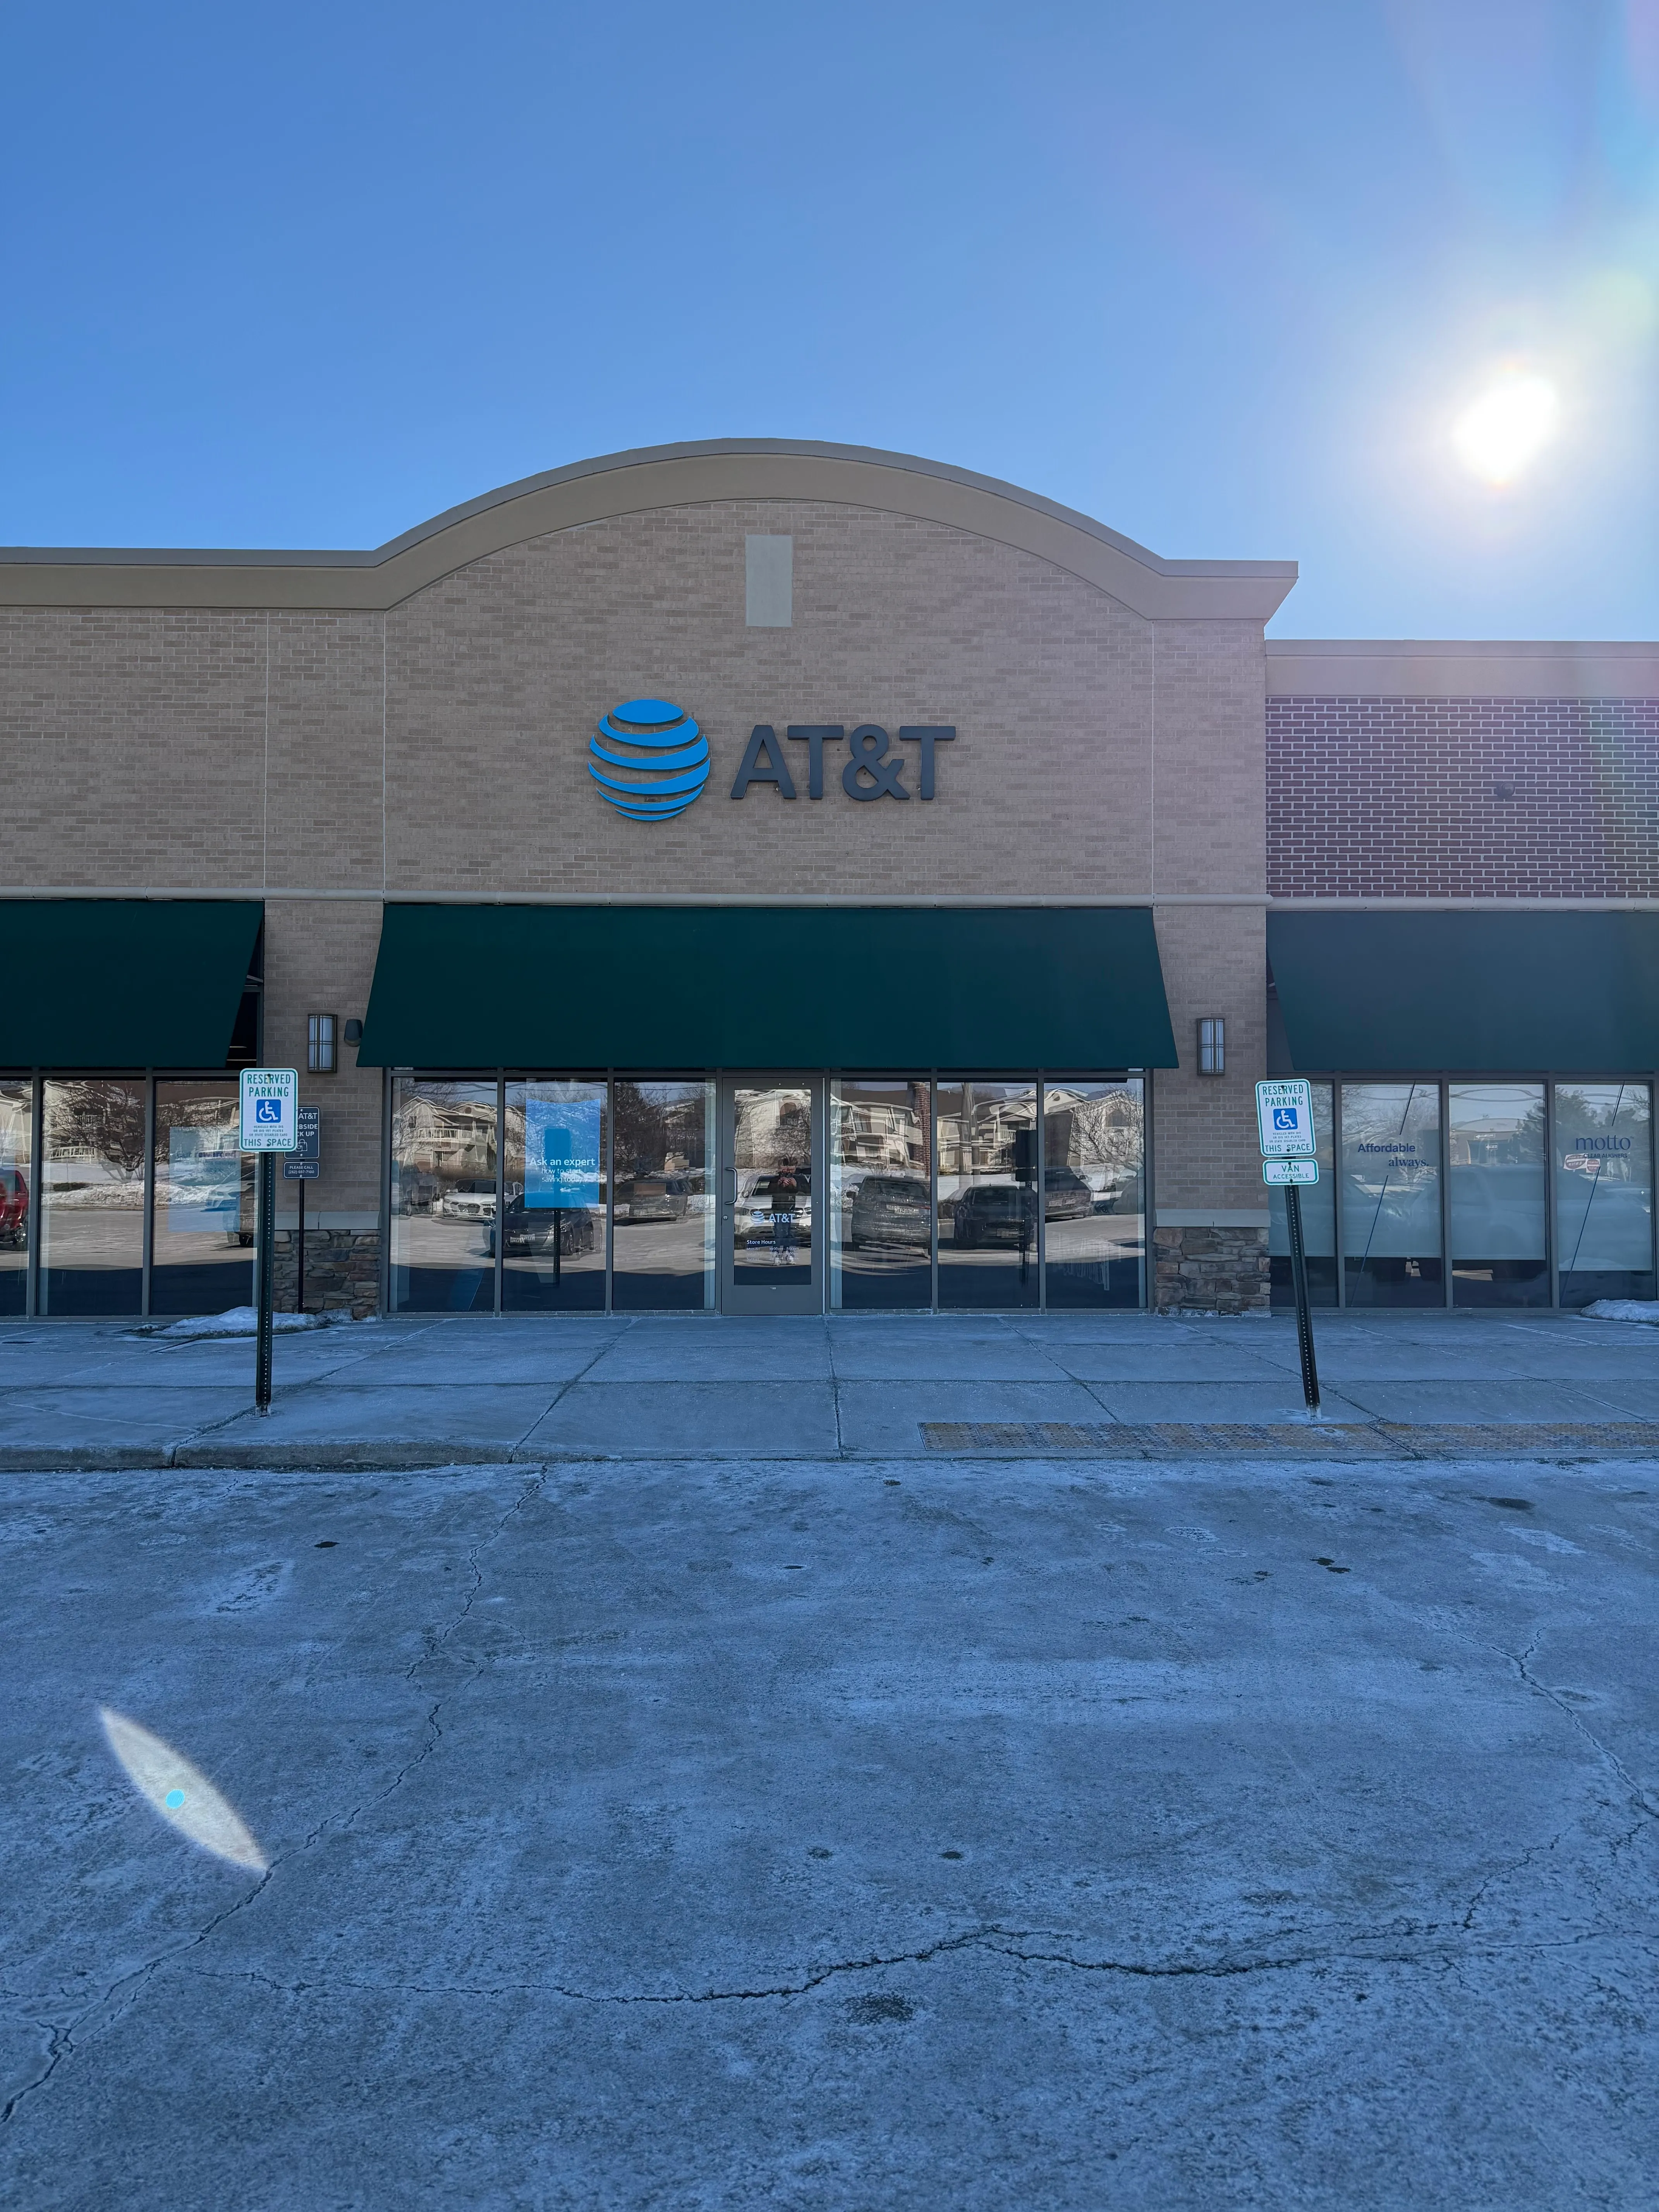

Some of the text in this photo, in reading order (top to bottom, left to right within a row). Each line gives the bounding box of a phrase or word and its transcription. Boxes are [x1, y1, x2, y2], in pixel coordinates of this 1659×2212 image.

[730, 724, 956, 801] AT&T
[247, 1074, 290, 1084] RESERVED
[249, 1087, 289, 1097] PARKING
[1262, 1084, 1303, 1095] RESERVED
[1265, 1096, 1303, 1107] PARKING
[1286, 1143, 1310, 1152] SPACE
[1358, 1143, 1416, 1152] Affordable
[1576, 1135, 1631, 1150] motto
[529, 1157, 548, 1166] Ask
[564, 1158, 596, 1168] expert
[1389, 1157, 1430, 1169] always.
[542, 1175, 562, 1183] saving
[769, 1213, 795, 1223] AT&T
